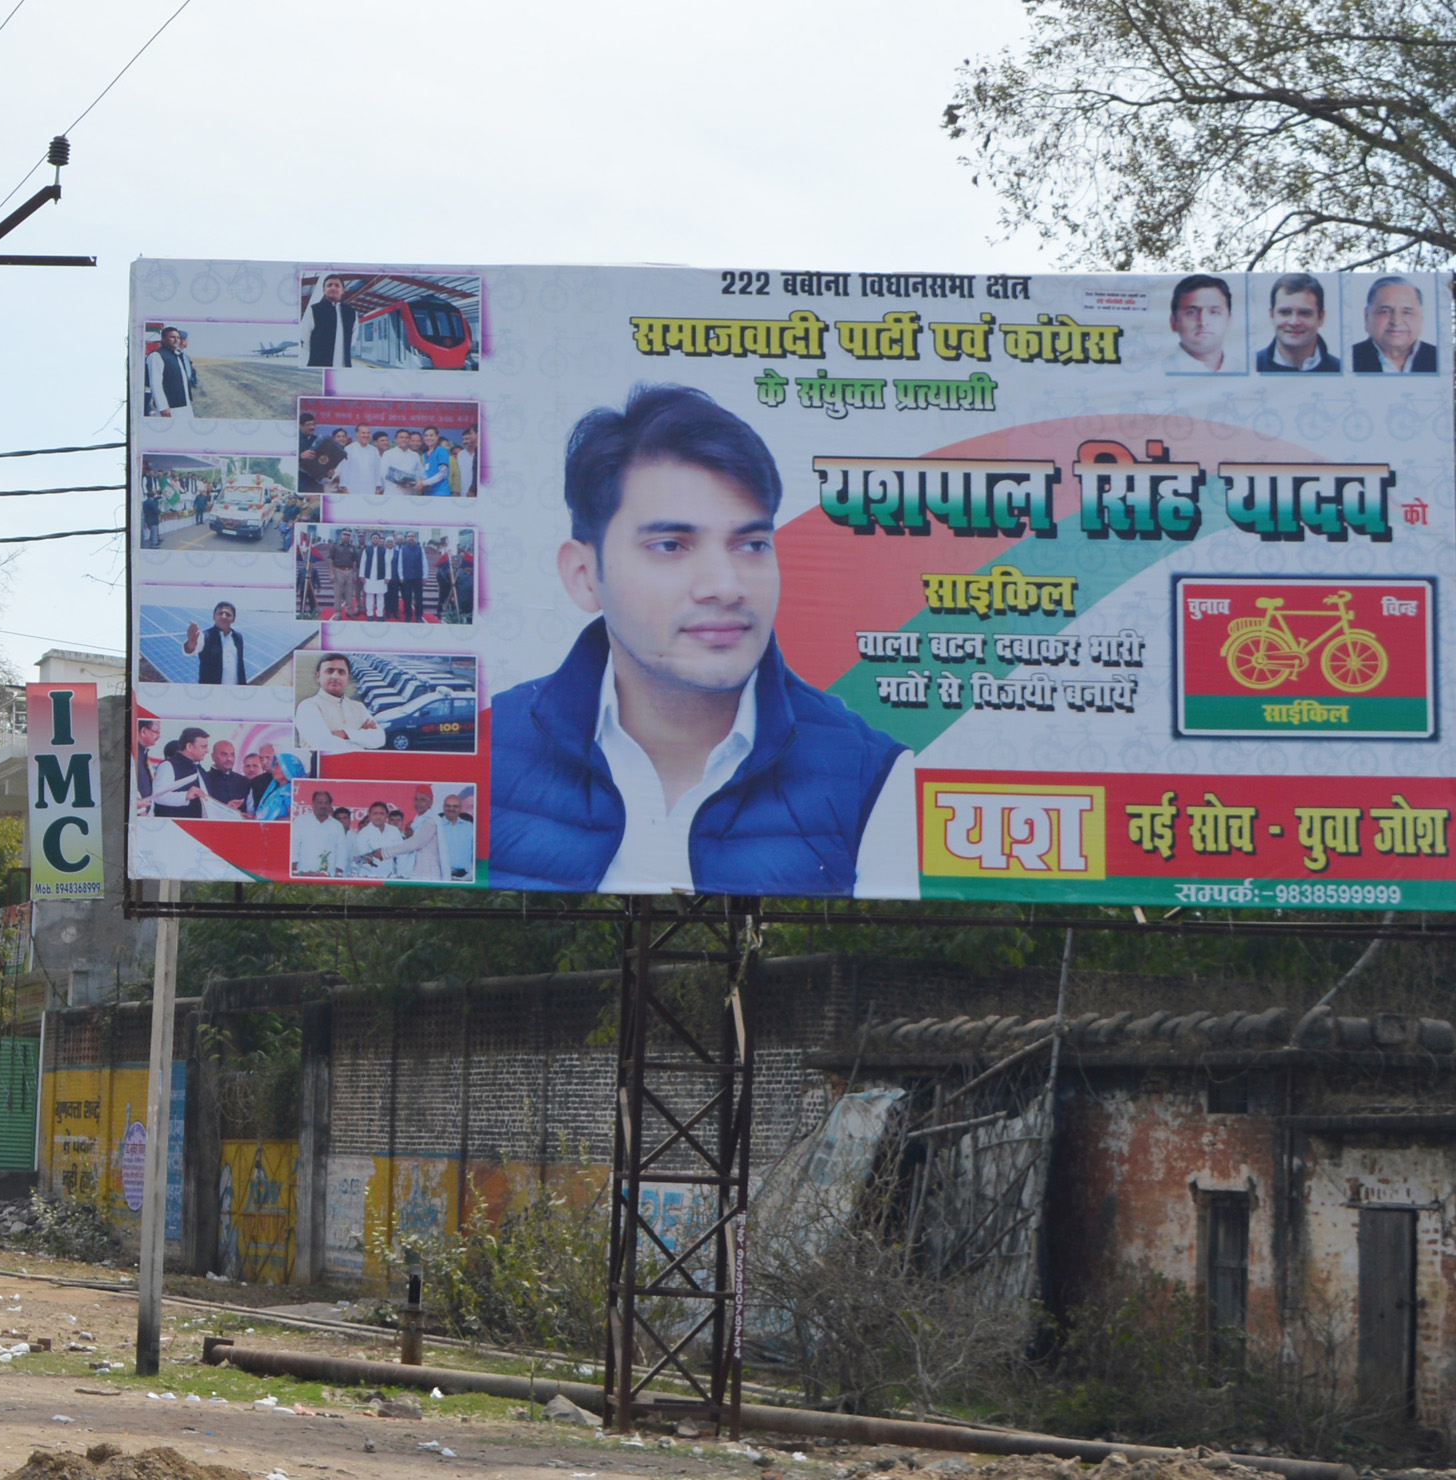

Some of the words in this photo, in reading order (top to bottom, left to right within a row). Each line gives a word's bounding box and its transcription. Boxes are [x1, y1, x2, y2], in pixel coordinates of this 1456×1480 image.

[721, 271, 770, 296] 222
[630, 310, 829, 360] समाजवादी
[835, 312, 923, 361] पार्टी
[929, 313, 996, 363] एवं
[999, 315, 1124, 365] कांग्रेस
[754, 368, 789, 407] के
[795, 369, 887, 420] संयुक्त
[893, 372, 998, 412] प्रत्याशी
[813, 456, 1062, 541] यशपाल
[1072, 440, 1206, 541] सिंह
[1218, 462, 1397, 542] यादव
[1402, 498, 1430, 525] को
[920, 564, 1078, 621] साइकिल
[1187, 598, 1231, 620] चुनाव
[1380, 596, 1418, 616] चिन्ह
[855, 631, 922, 663] वाला
[927, 632, 987, 664] बटन
[992, 633, 1080, 666] दबाकर
[1088, 628, 1145, 667] भारी
[875, 669, 932, 709] मतों
[937, 670, 962, 709] से
[970, 671, 1056, 712] विजयी
[1062, 673, 1138, 713] बनायें
[1261, 699, 1349, 725] साईकिल
[34, 690, 95, 873] IMC
[936, 791, 1094, 872] यश
[1125, 792, 1178, 860] नई
[1186, 792, 1258, 855] सोच
[1294, 807, 1363, 873] युवा
[1369, 794, 1450, 857] जोश
[35, 883, 53, 894] Mob.
